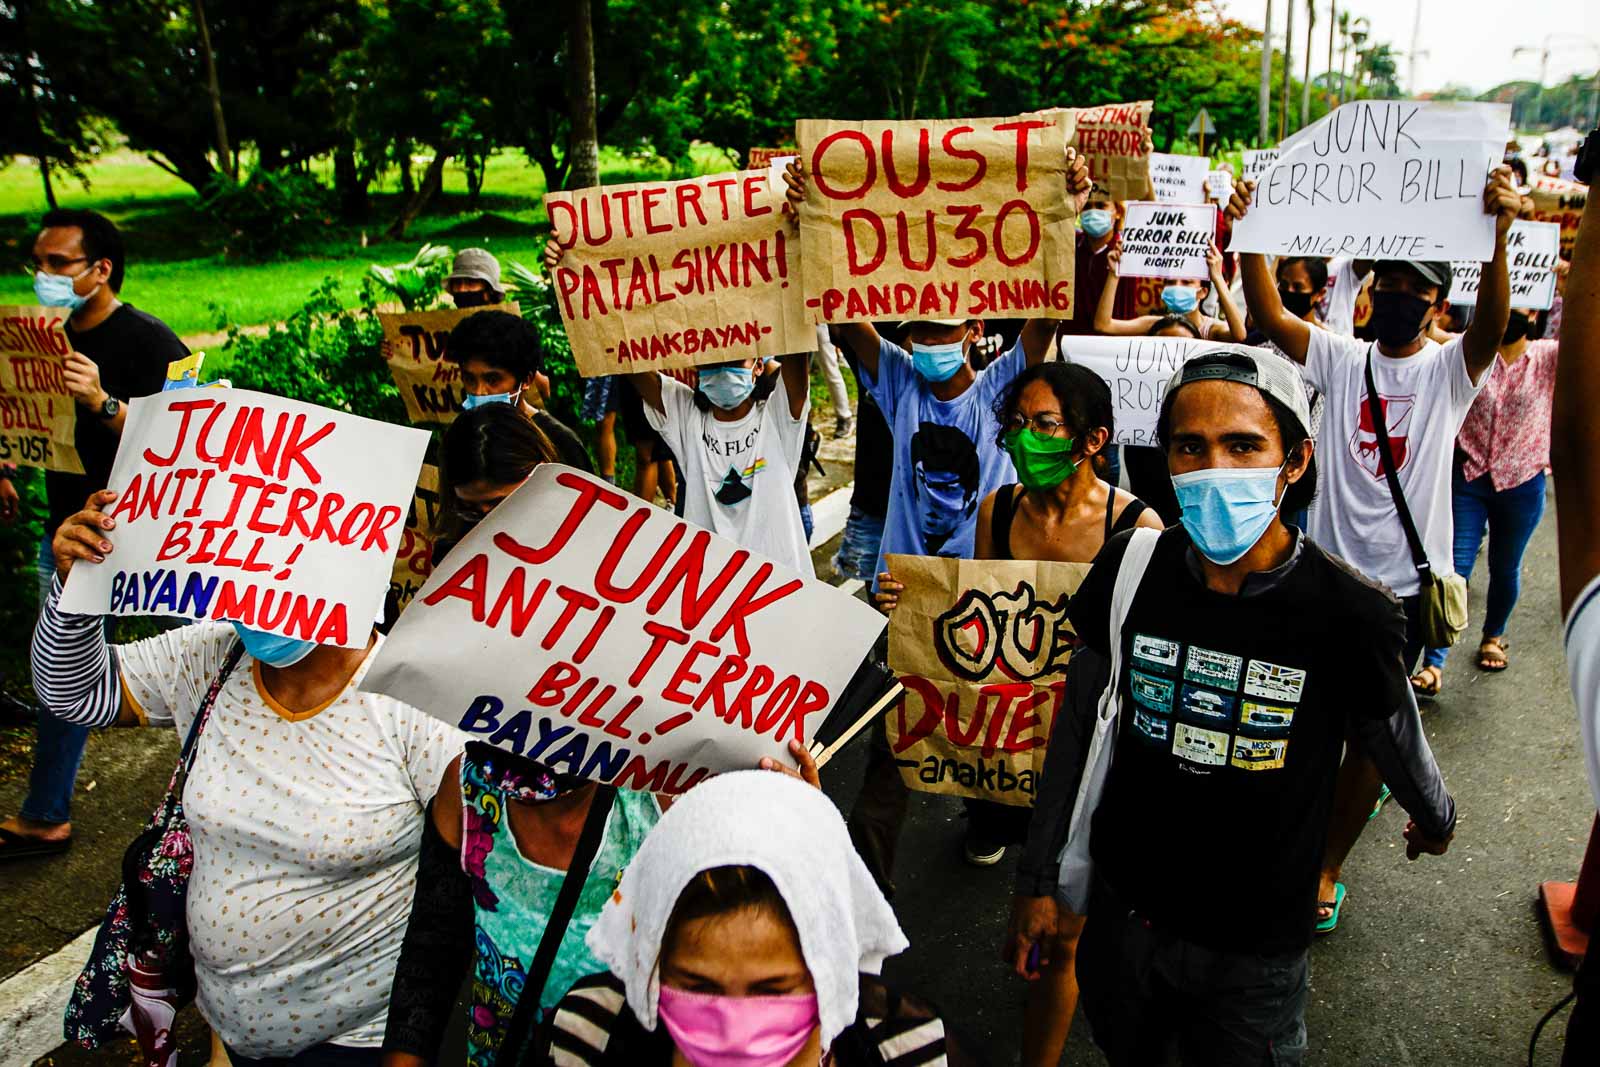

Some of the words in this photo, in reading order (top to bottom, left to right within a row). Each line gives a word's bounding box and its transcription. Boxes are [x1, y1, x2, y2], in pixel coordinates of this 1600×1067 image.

[1076, 128, 1143, 158] TERROR
[1313, 103, 1420, 156] JUNK
[812, 120, 1056, 200] OUST
[842, 200, 1041, 275] DU30
[1123, 227, 1172, 244] TERROR
[1147, 211, 1186, 226] JUNK
[1122, 244, 1160, 255] UPHOLD
[1144, 257, 1185, 270] RIGHTS!
[557, 230, 788, 320] PATALSIKIN!
[968, 279, 1070, 314] SINING
[1523, 272, 1550, 283] NOT
[606, 321, 771, 363] -ANAKBAYAN-
[143, 399, 336, 484] JUNK
[109, 468, 215, 523] ANTI
[217, 474, 401, 552] TERROR
[156, 521, 304, 580] BILL!
[494, 472, 803, 666] JUNK
[424, 553, 615, 664] ANTI
[629, 621, 829, 742] TERROR
[527, 661, 692, 745] BILL!
[609, 757, 720, 795] MU
[895, 756, 1041, 794] -anakba
